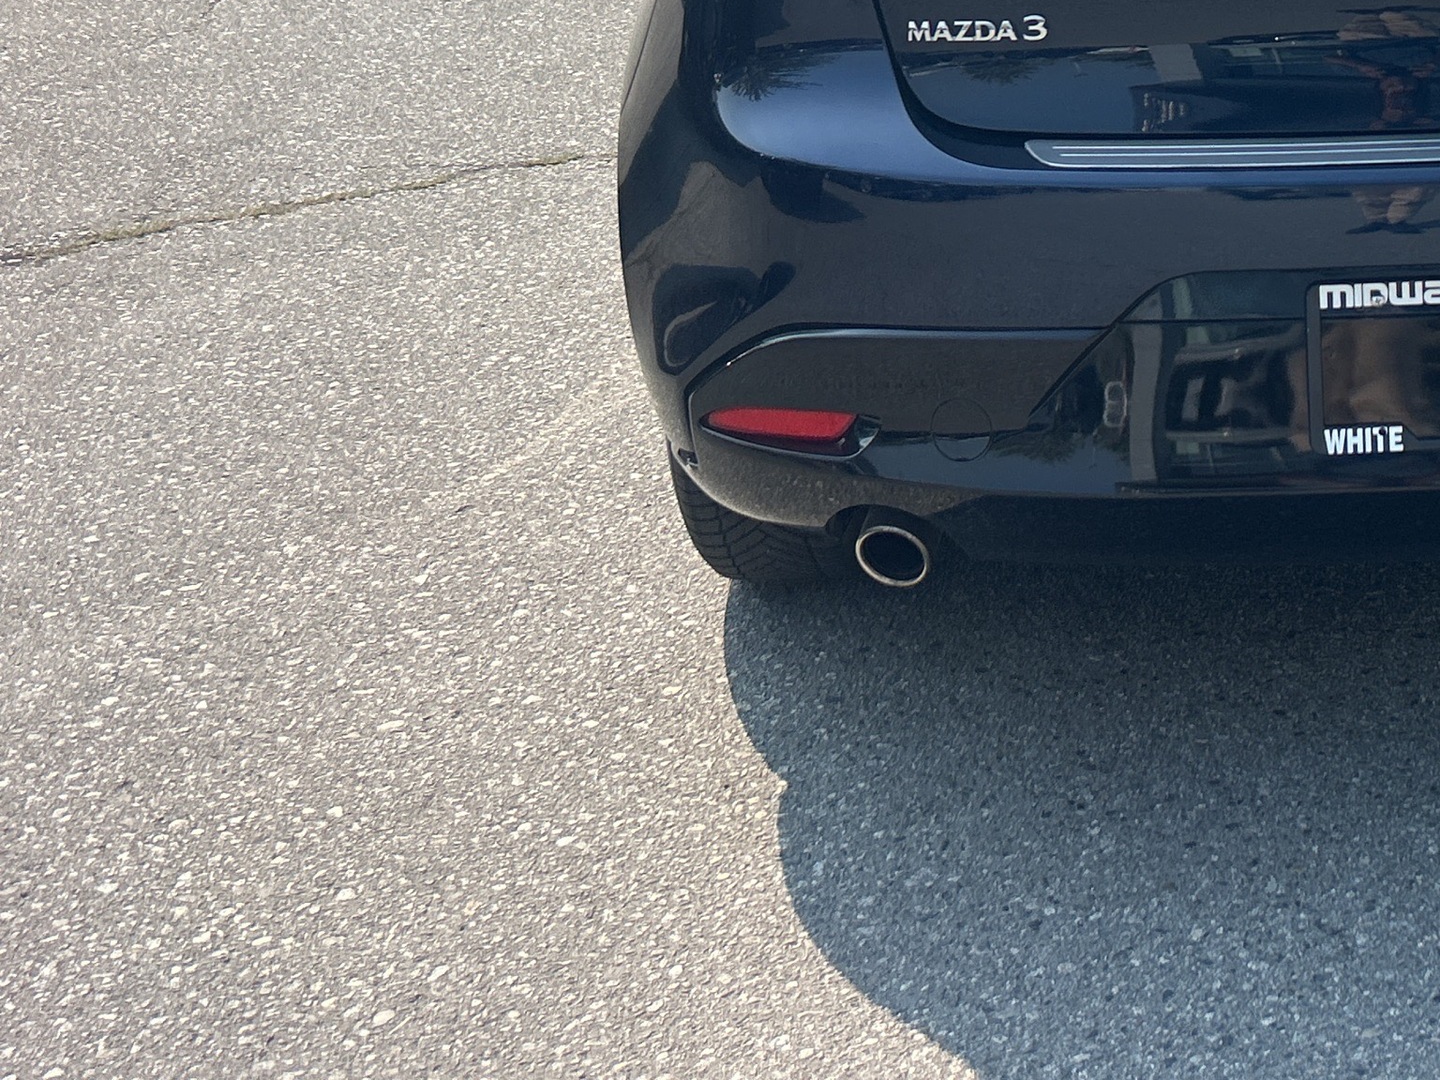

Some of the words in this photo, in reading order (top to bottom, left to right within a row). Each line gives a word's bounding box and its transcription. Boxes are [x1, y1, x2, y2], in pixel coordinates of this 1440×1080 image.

[907, 20, 1017, 42] MAZDA
[1022, 14, 1048, 41] 3
[1324, 425, 1404, 455] WHITE
